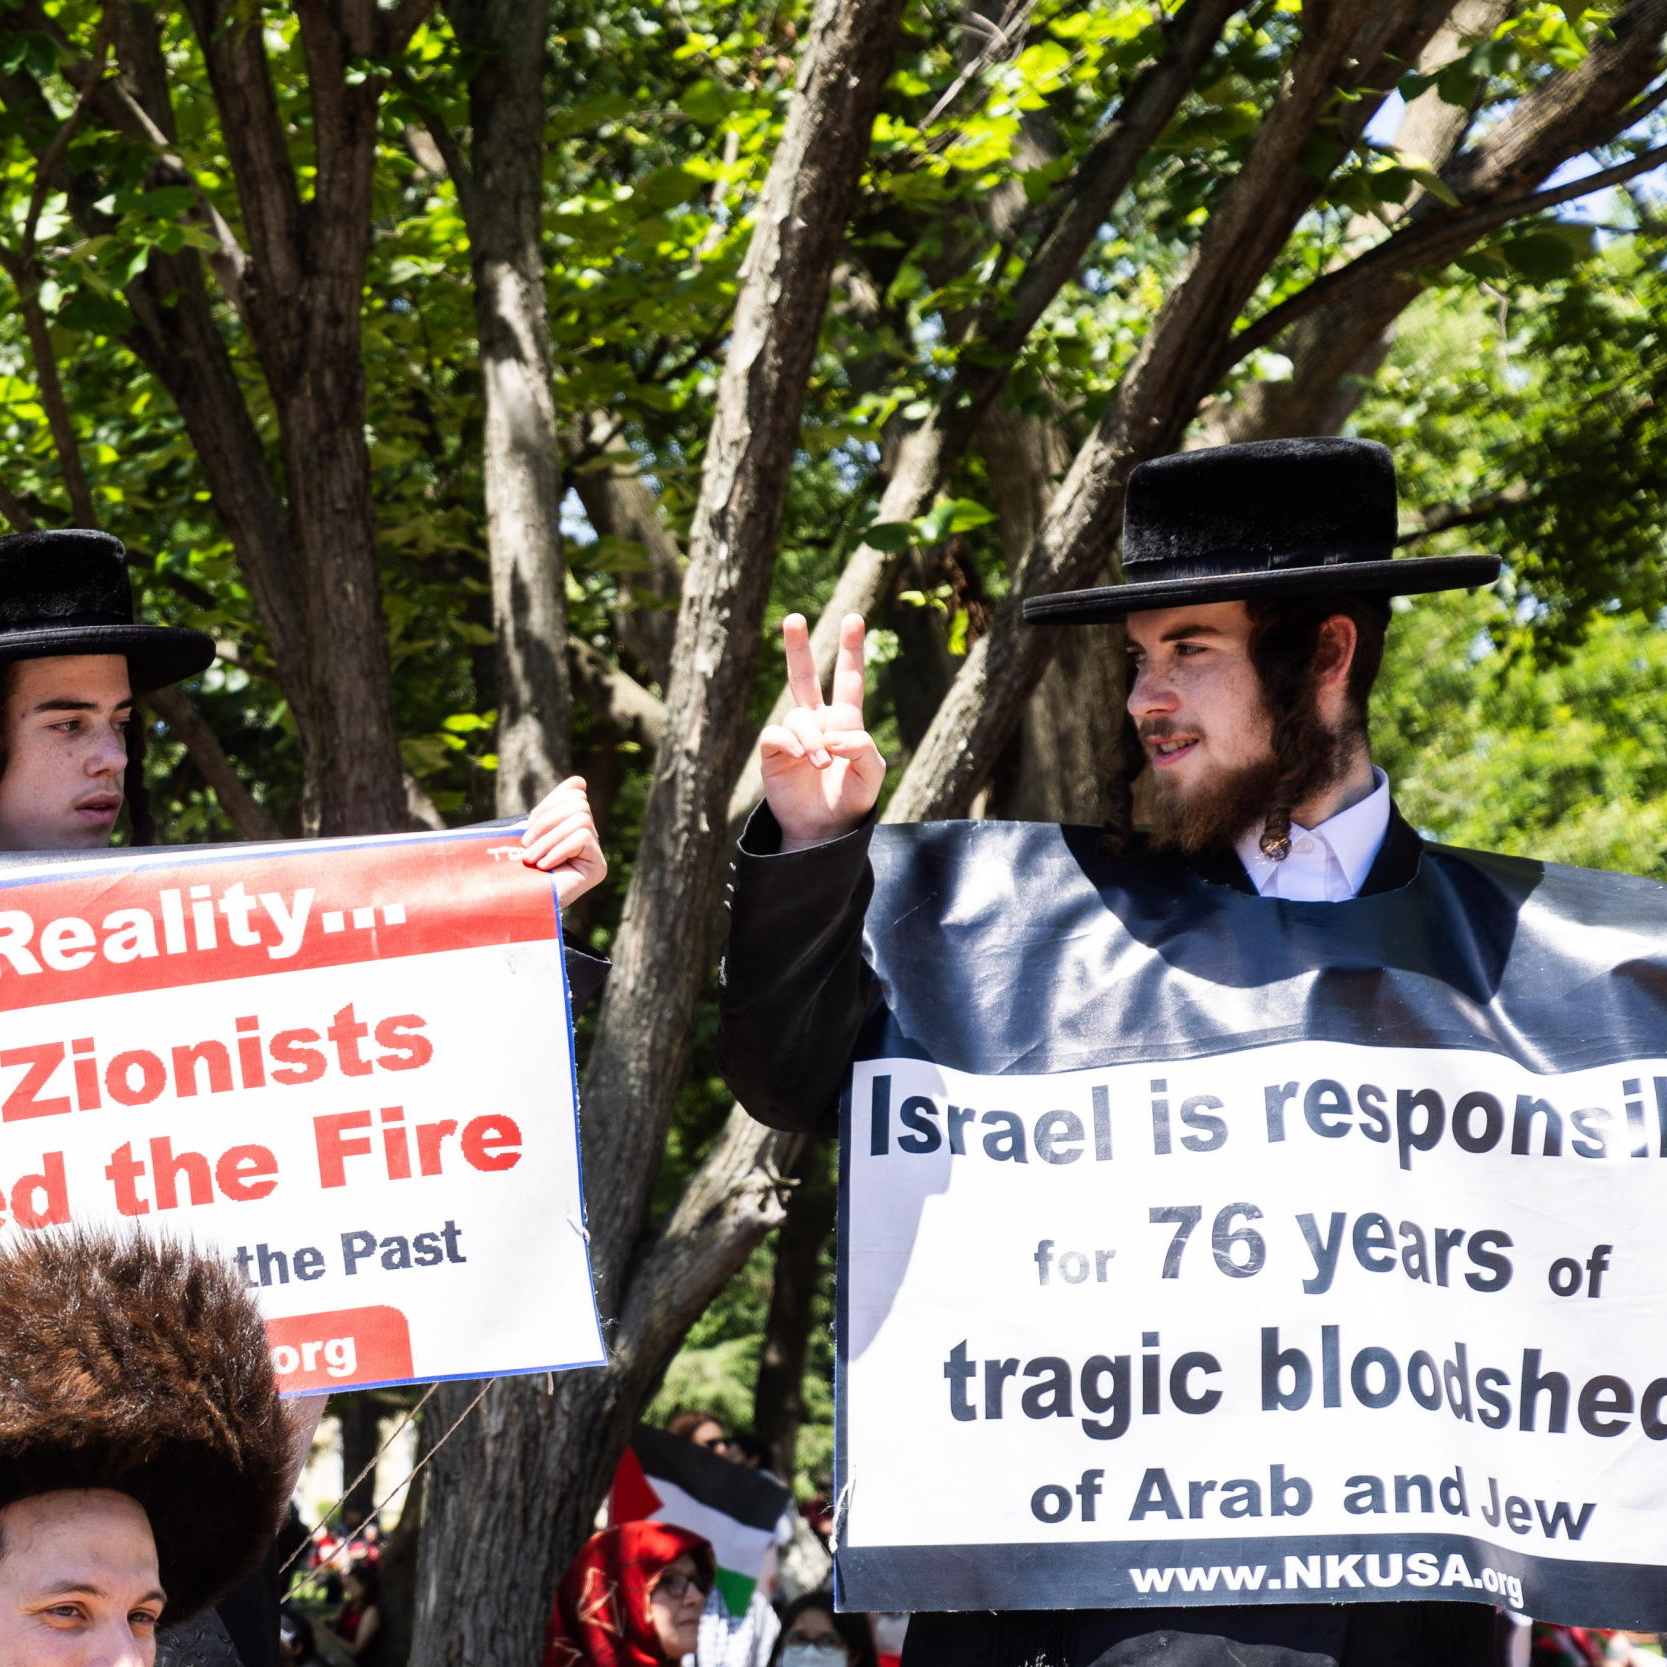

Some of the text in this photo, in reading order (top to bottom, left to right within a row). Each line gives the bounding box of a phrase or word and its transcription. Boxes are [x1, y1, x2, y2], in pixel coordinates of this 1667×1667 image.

[104, 1135, 279, 1218] the
[313, 1102, 523, 1189] Fire
[868, 1074, 1113, 1165] Israel
[1149, 1078, 1230, 1157] is
[234, 1219, 467, 1288] the Past
[1033, 1201, 1614, 1299] for 76 years of
[272, 1336, 358, 1378] org
[943, 1330, 1224, 1441] tragic
[1030, 1463, 1598, 1542] of Arab and Jew
[1128, 1551, 1523, 1611] www.NKUSA.org
